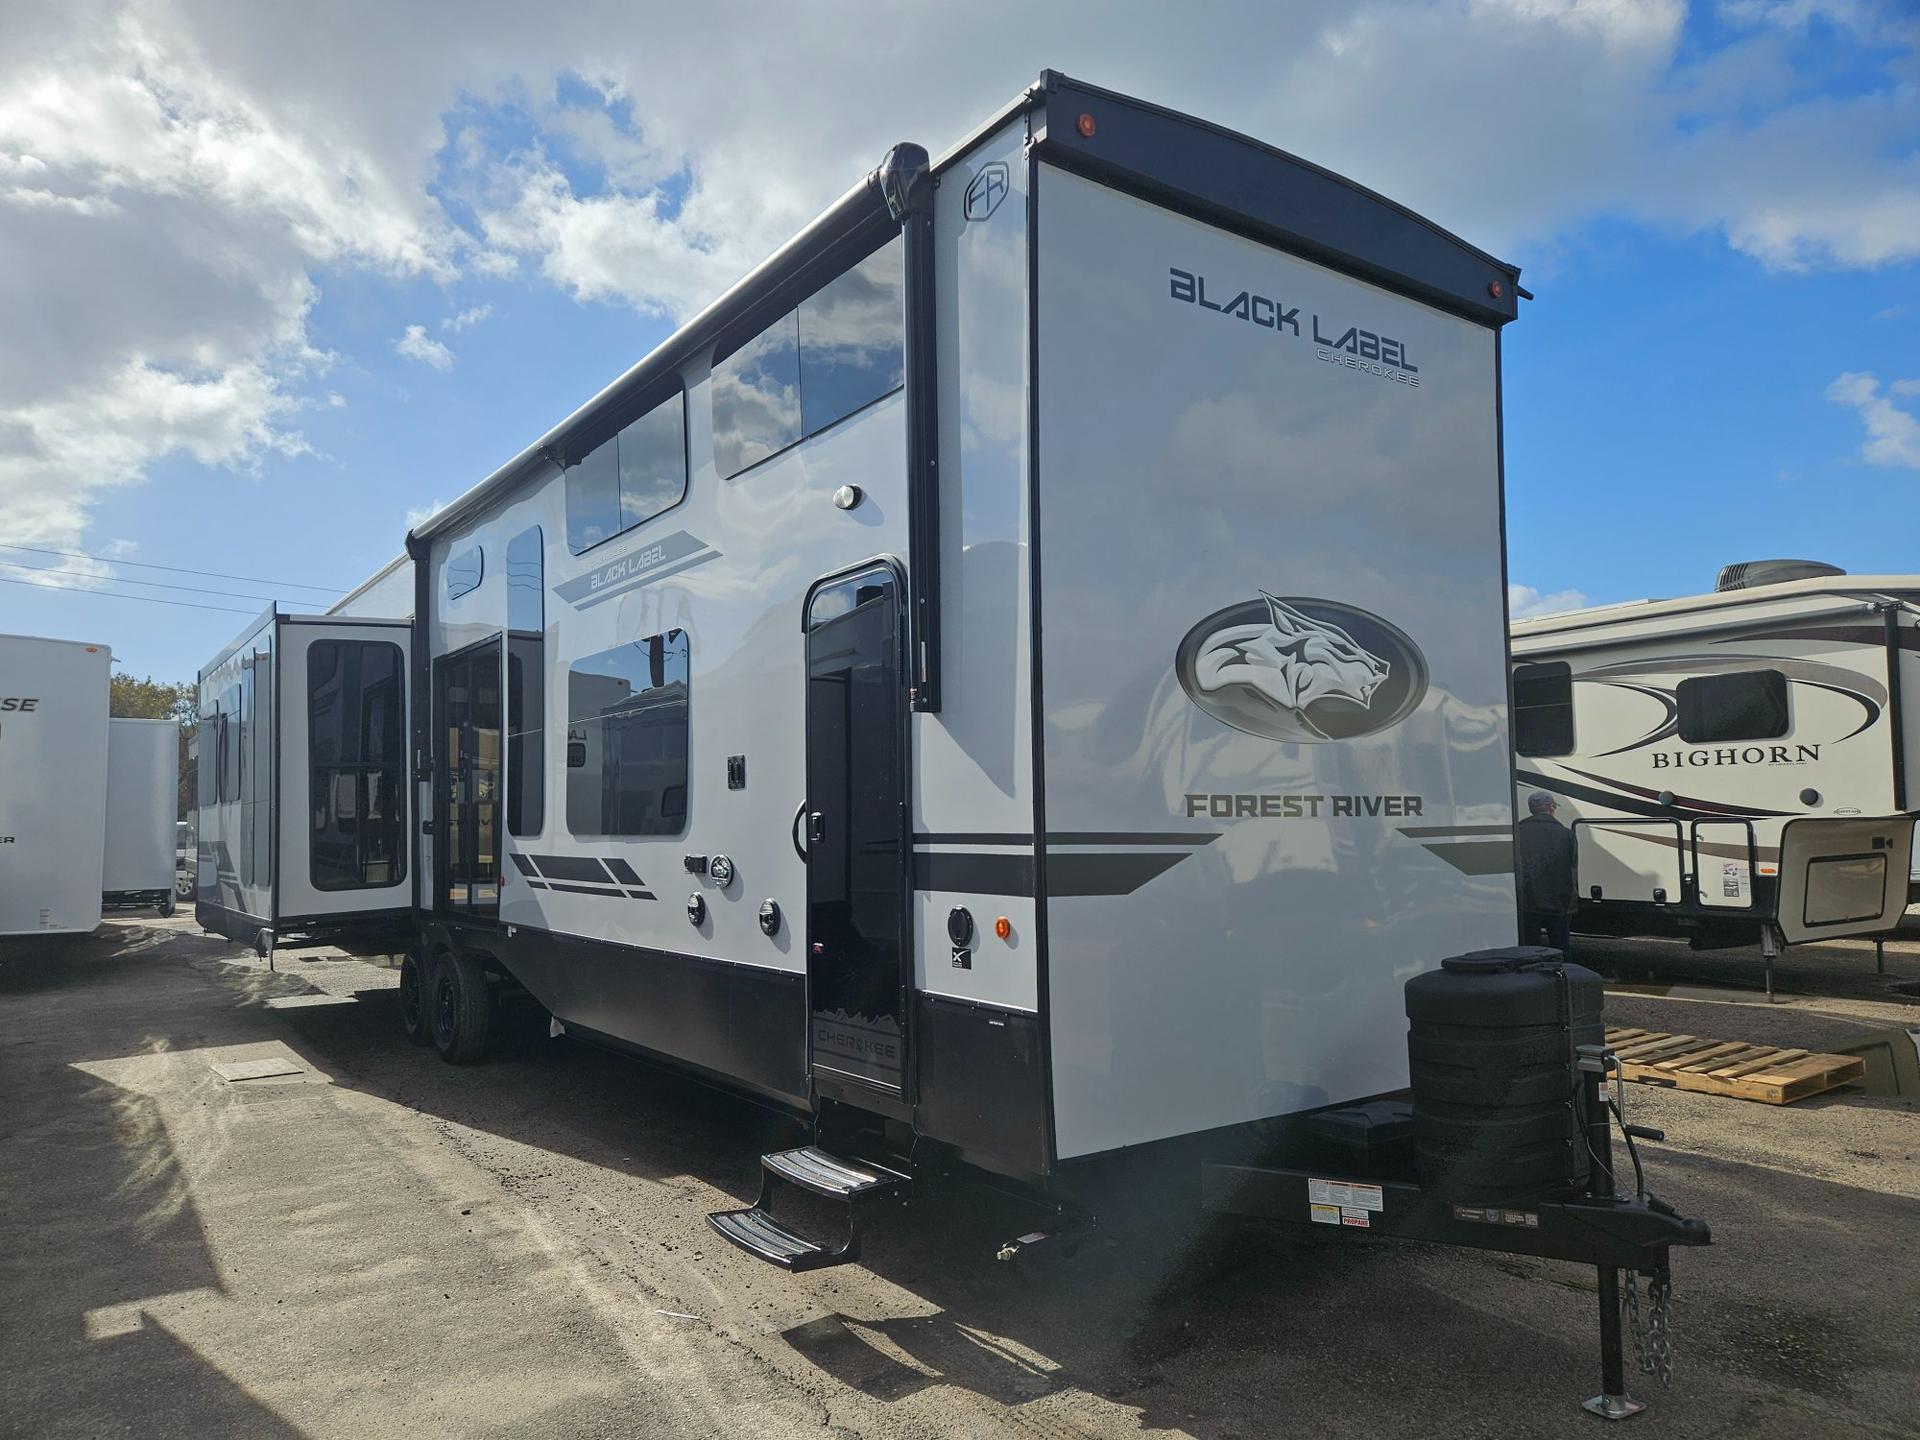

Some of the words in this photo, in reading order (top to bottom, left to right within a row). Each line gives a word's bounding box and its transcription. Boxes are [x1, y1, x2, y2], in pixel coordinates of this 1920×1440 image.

[1170, 267, 1301, 336] BLACK
[1313, 314, 1418, 373] LABEL
[1317, 347, 1420, 387] CHEROKEE
[590, 562, 627, 590] BLACK
[628, 545, 667, 571] LABEL
[0, 697, 40, 712] SE
[1651, 744, 1822, 769] BIGHORN
[1184, 794, 1324, 818] FOREST
[1331, 795, 1423, 817] RIVER
